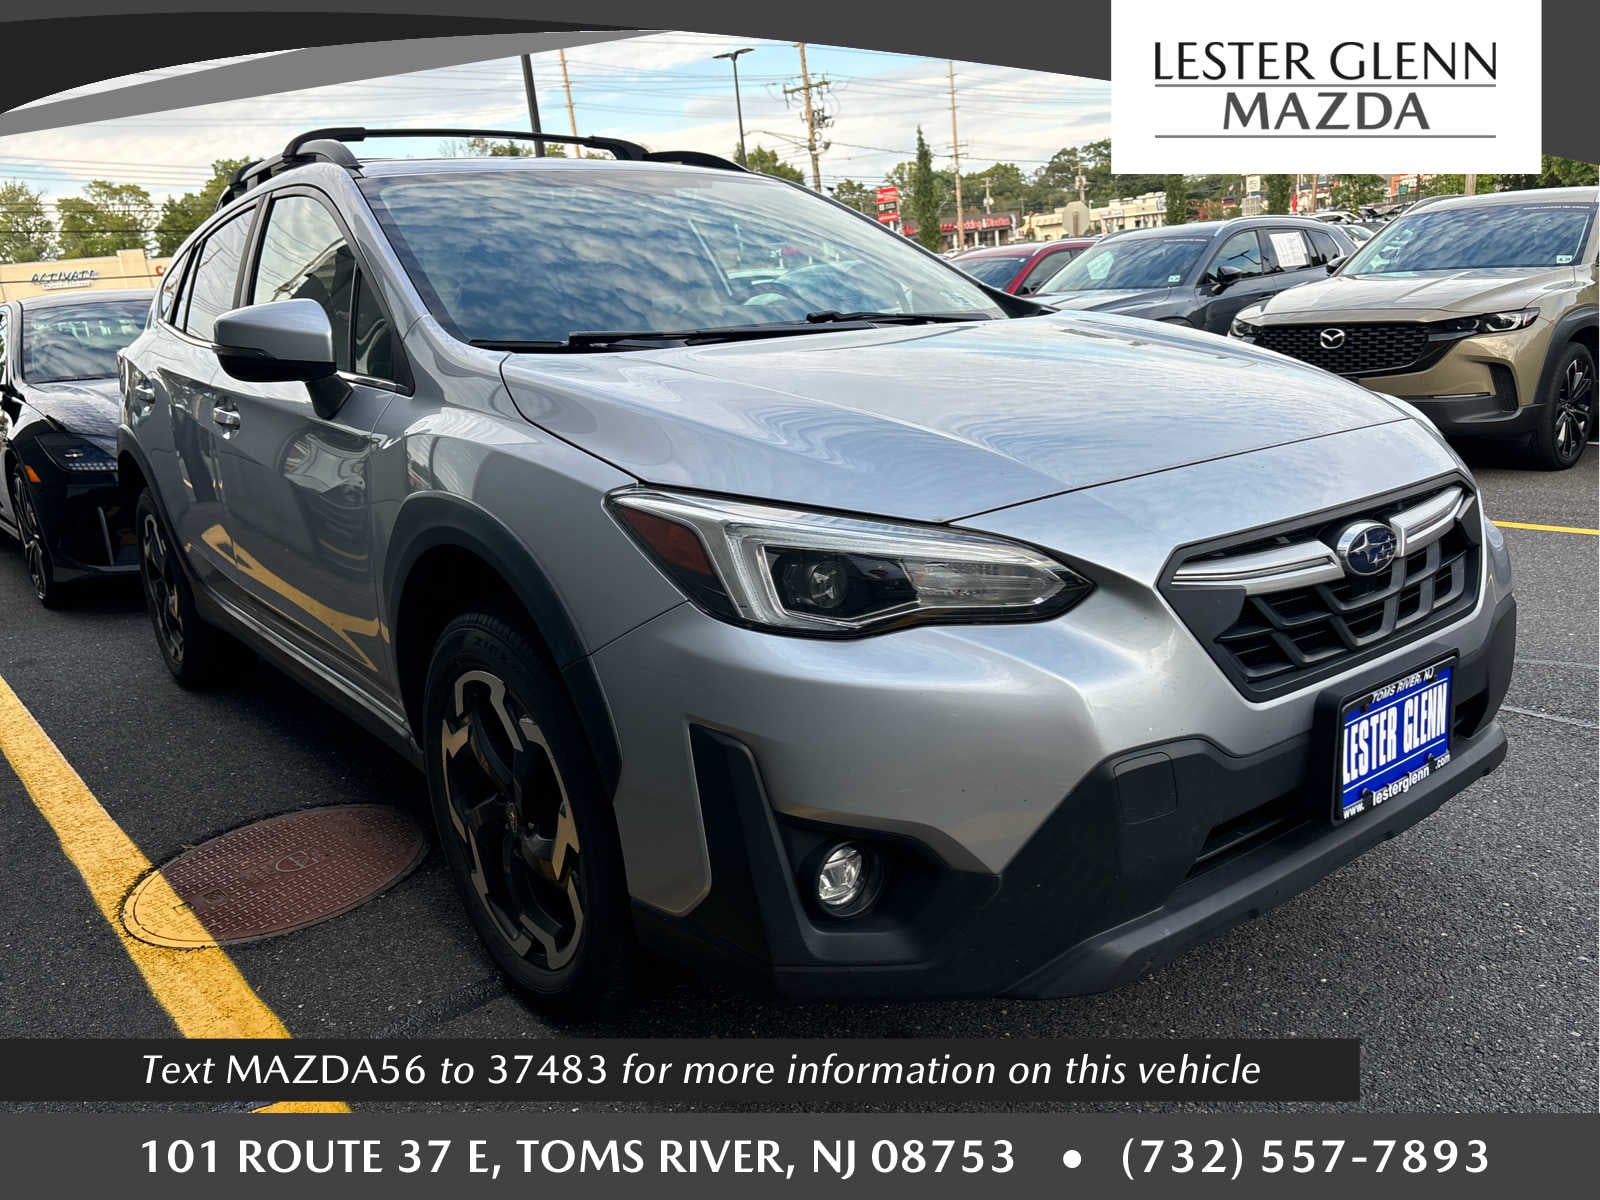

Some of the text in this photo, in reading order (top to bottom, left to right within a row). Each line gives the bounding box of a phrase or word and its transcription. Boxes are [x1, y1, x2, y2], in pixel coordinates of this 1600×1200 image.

[1371, 684, 1395, 703] TOMS
[1423, 668, 1435, 681] NJ
[1343, 683, 1448, 784] LESTER GLENN
[1372, 765, 1430, 807] lesterglenn
